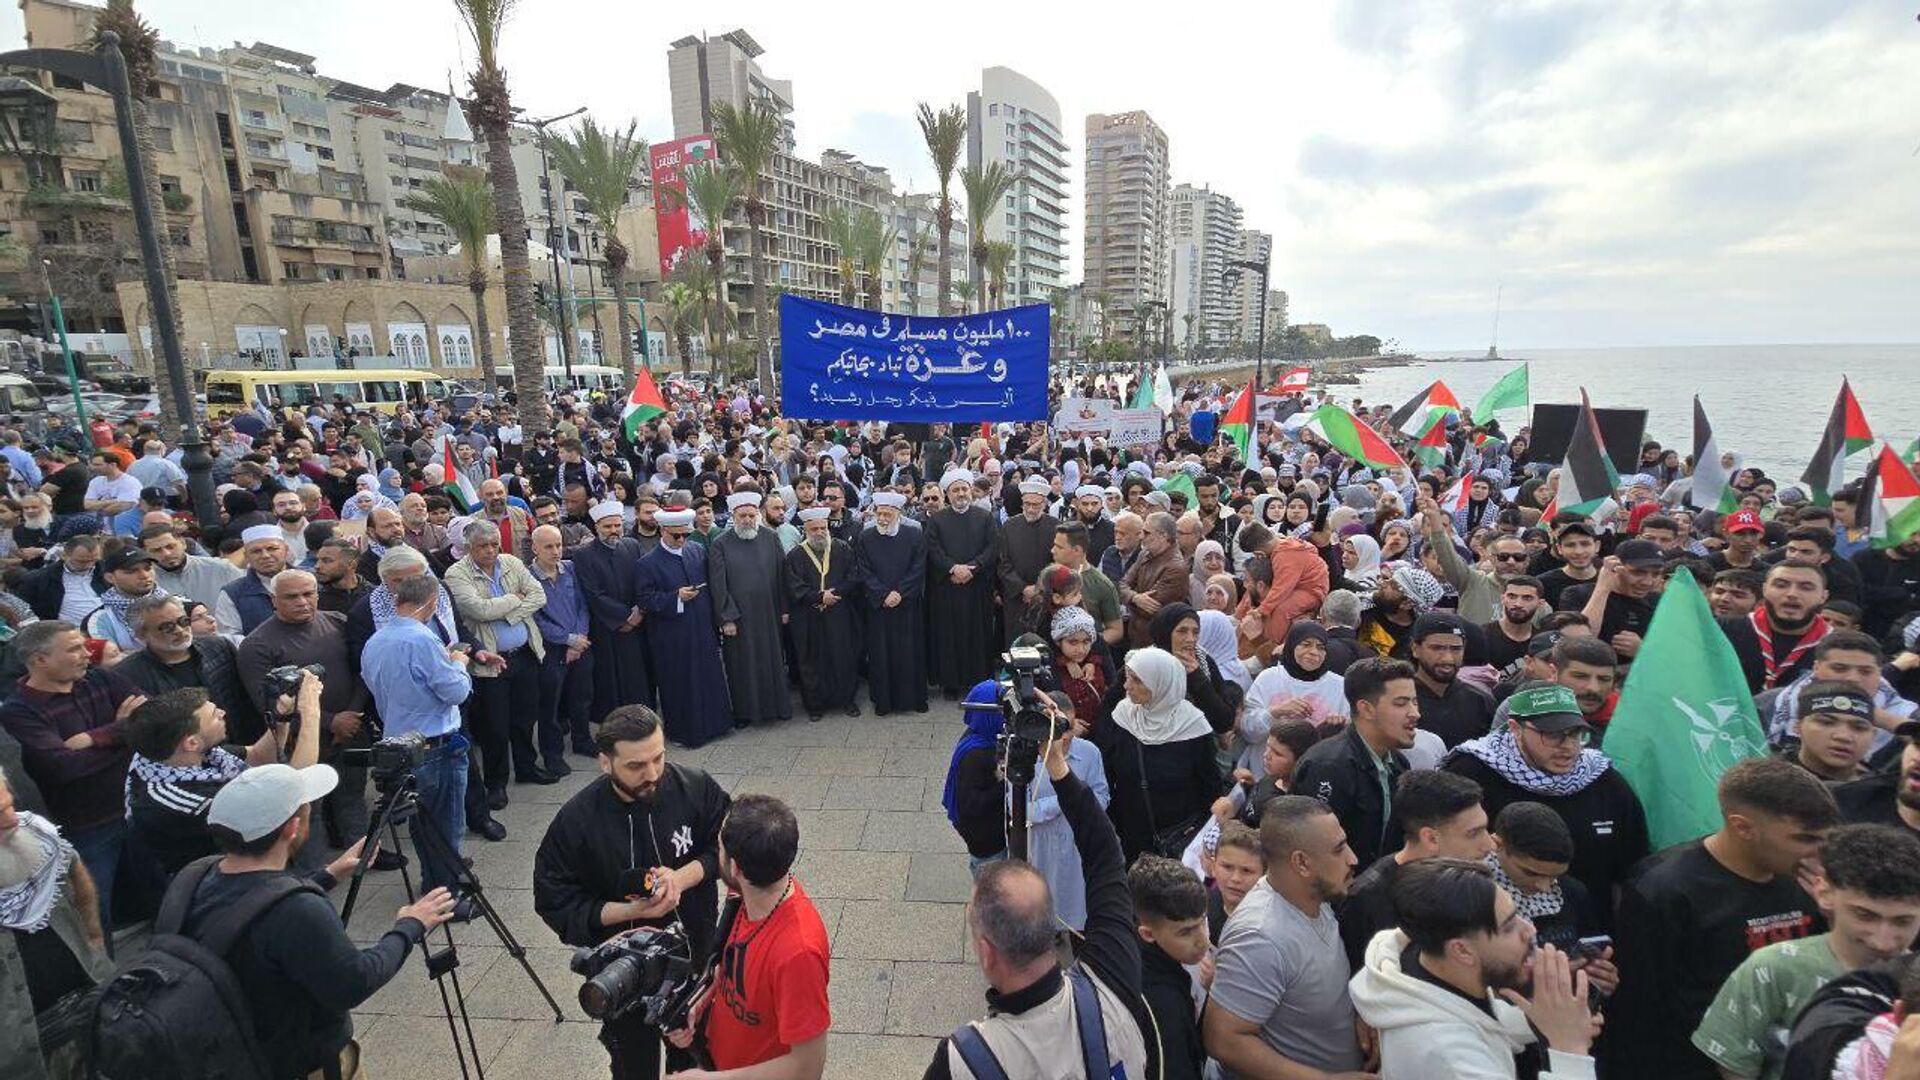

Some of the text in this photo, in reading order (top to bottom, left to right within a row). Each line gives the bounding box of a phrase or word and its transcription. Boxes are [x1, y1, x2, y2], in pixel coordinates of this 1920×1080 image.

[807, 319, 868, 339] مصر
[889, 317, 947, 347] مسلم
[953, 320, 1005, 347] مليون
